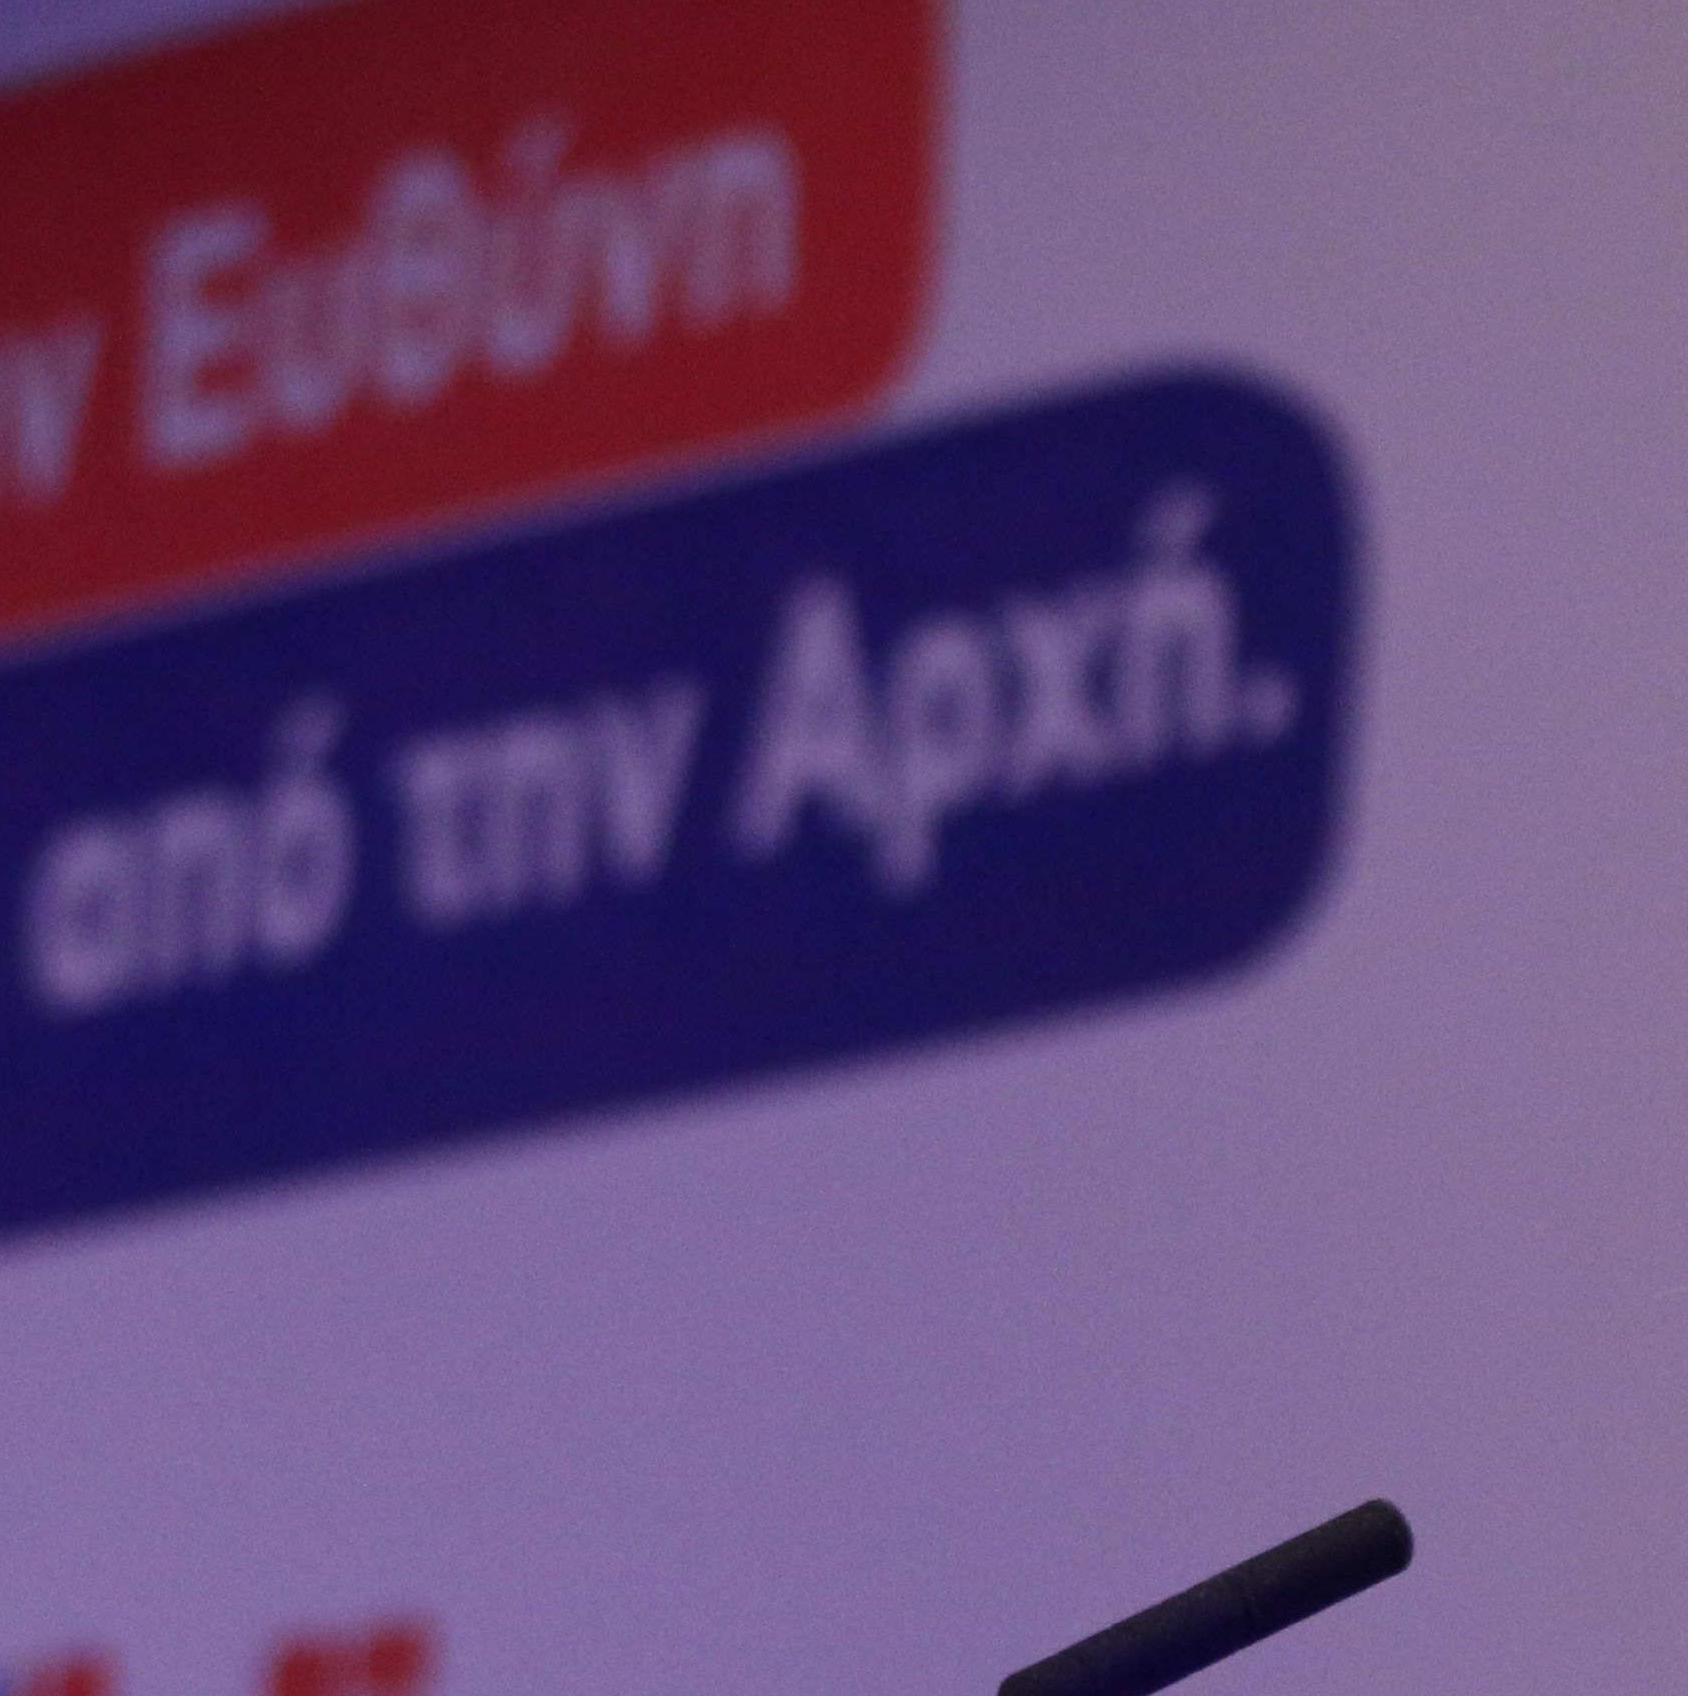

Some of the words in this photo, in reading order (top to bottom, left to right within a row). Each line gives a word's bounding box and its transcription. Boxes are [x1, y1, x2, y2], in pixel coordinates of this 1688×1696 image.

[139, 114, 797, 470] Ευθύνη
[27, 692, 354, 1011] από
[396, 680, 703, 926] την
[730, 479, 1297, 893] Αρχή.
